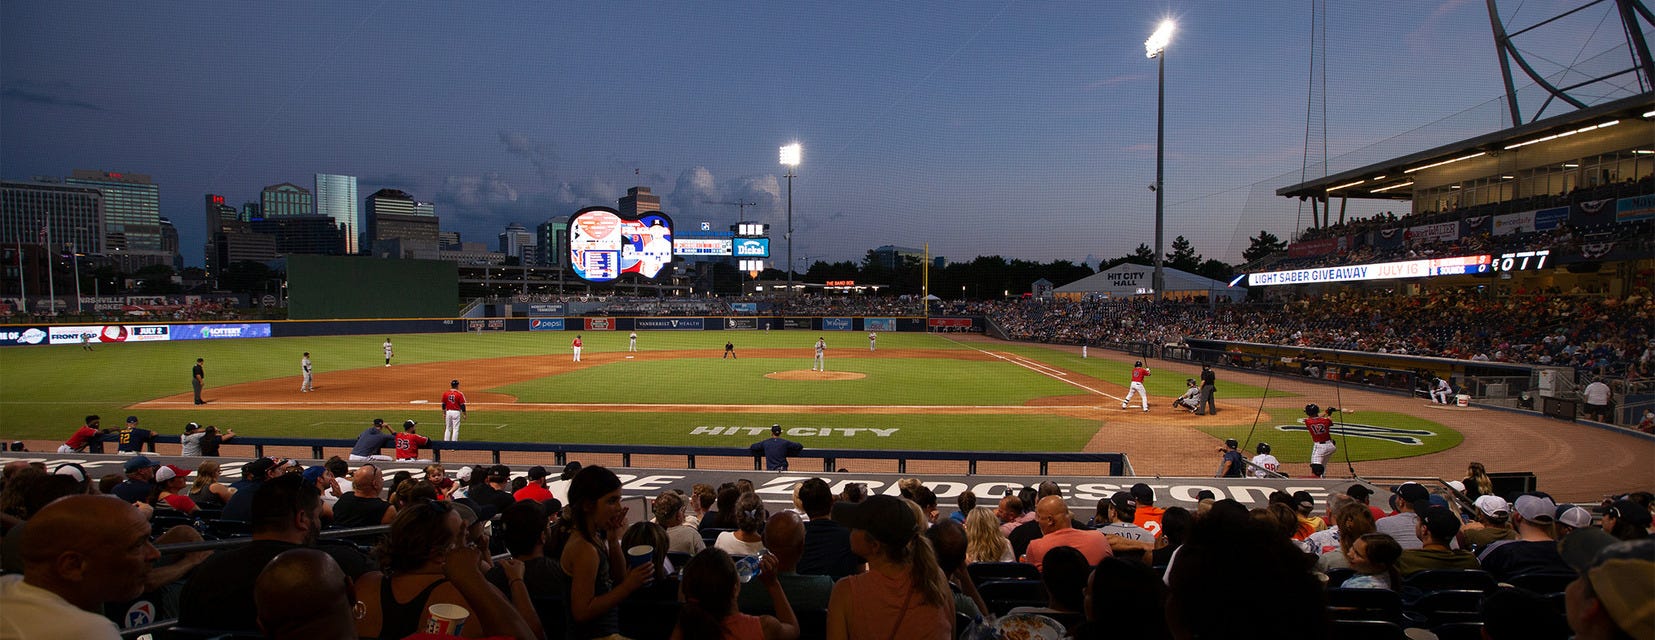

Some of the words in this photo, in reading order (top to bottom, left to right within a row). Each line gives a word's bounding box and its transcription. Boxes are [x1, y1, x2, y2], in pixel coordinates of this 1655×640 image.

[738, 245, 764, 254] Dickel
[1479, 264, 1485, 272] 0
[1502, 258, 1514, 271] 0
[1520, 257, 1529, 270] 1
[1537, 256, 1546, 269] 1
[1123, 272, 1144, 280] CITY
[1255, 273, 1277, 284] LIGHT
[1279, 272, 1309, 282] SABER
[1311, 266, 1367, 281] GIVEAWAY
[1377, 264, 1402, 277] JULY
[1407, 264, 1418, 274] 16
[8, 332, 19, 340] OF
[689, 426, 772, 435] HIT
[786, 427, 900, 437] CITY
[1311, 424, 1326, 435] 12
[120, 433, 130, 444] 12
